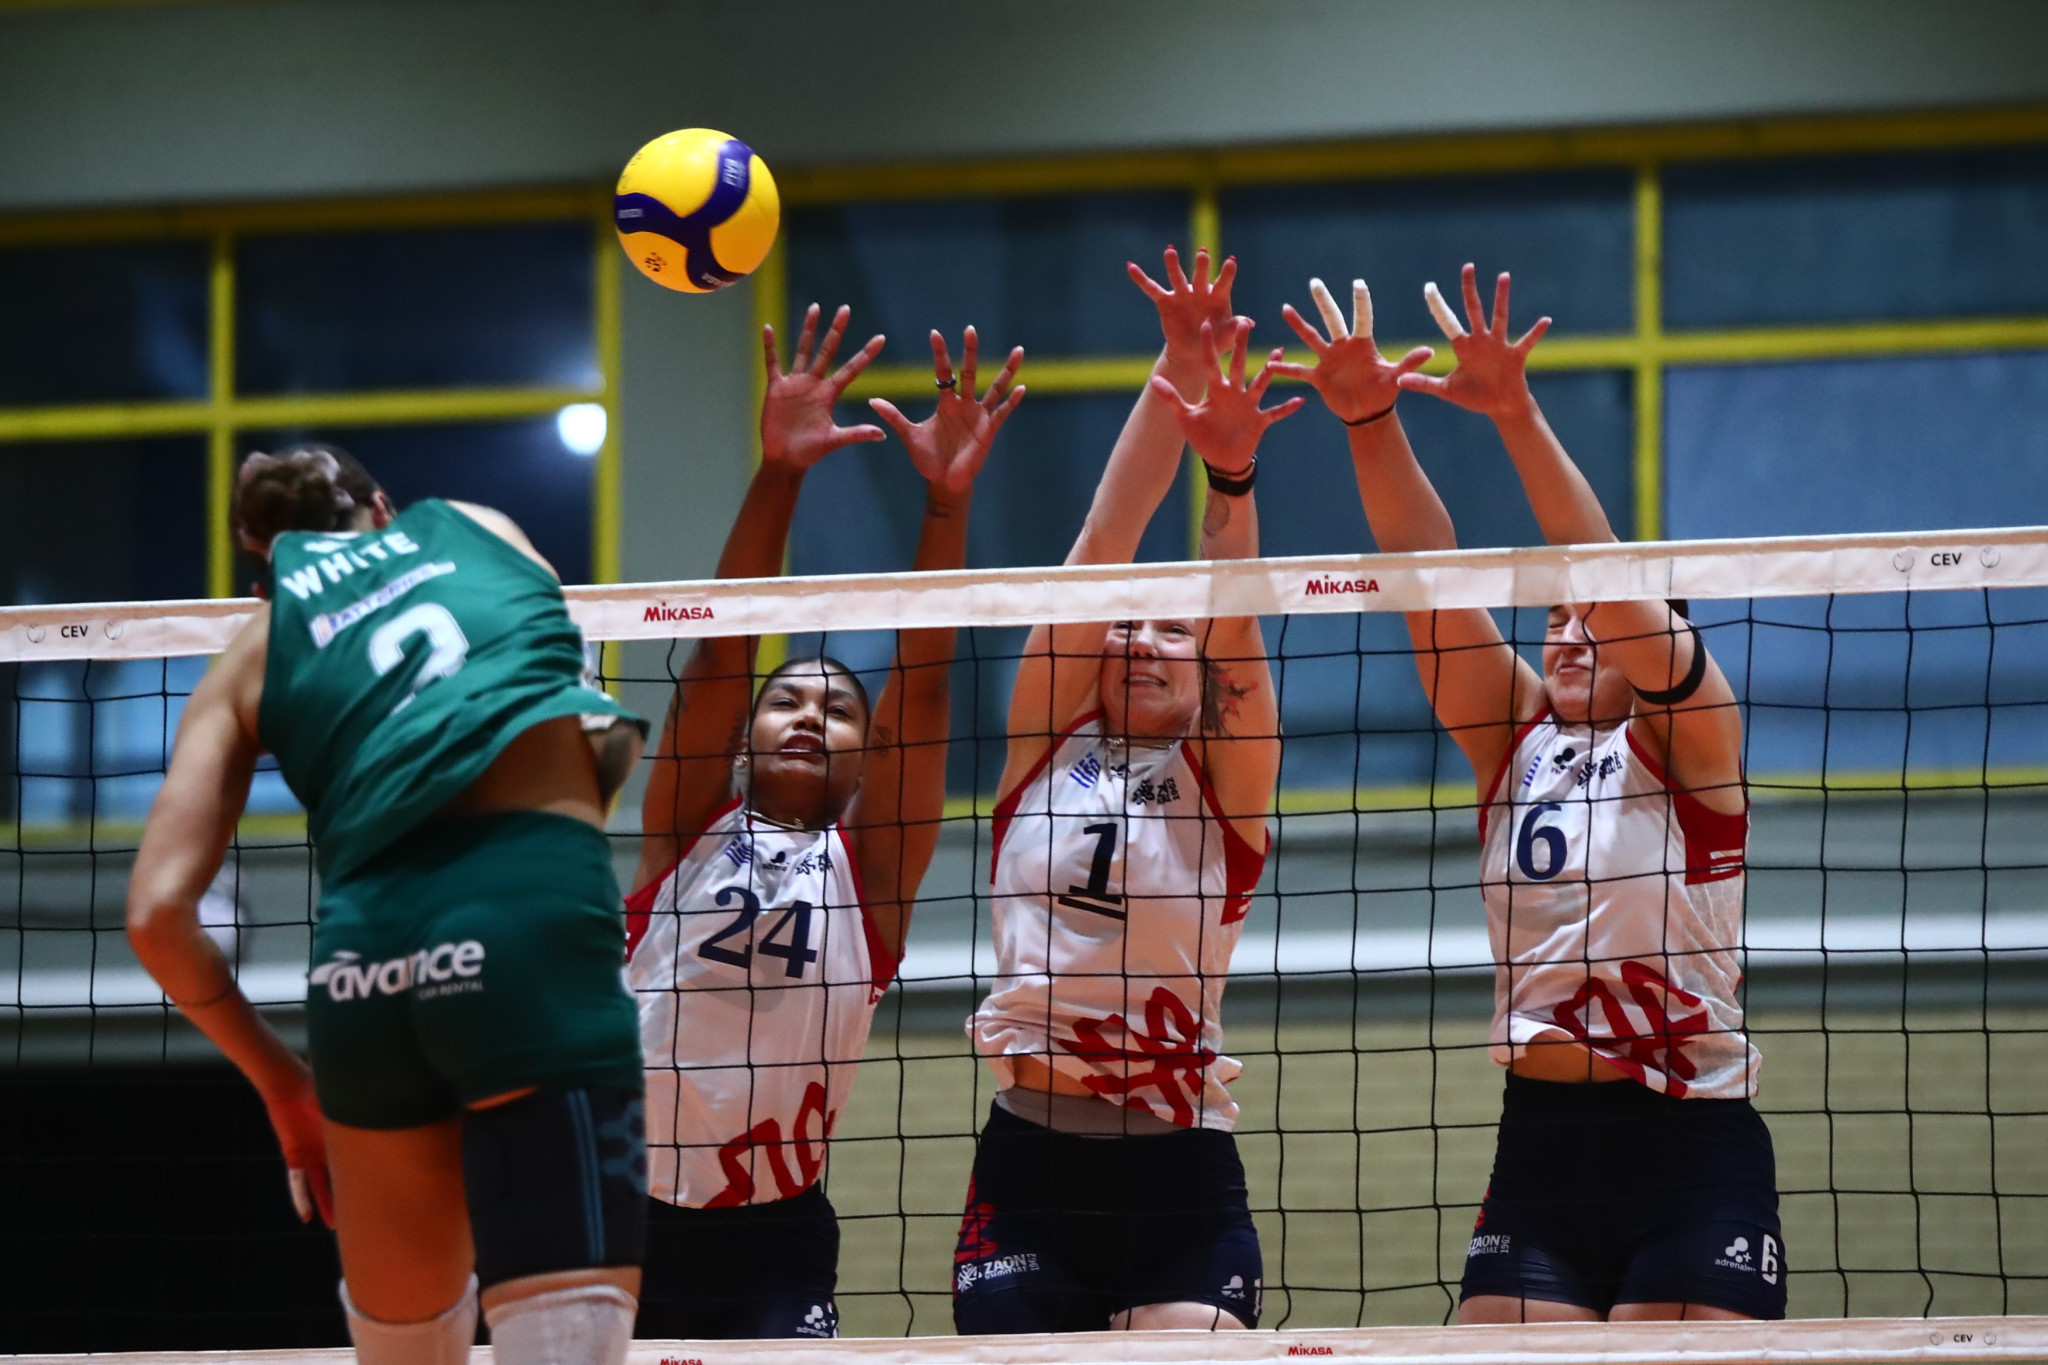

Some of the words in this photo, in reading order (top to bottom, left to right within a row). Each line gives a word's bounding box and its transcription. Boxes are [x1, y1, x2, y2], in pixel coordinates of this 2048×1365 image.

[281, 531, 420, 600] WHITE
[1931, 553, 1962, 567] CEV
[61, 625, 89, 639] CEV
[1069, 823, 1122, 905] 1
[1516, 801, 1568, 880] 6
[697, 886, 818, 979] 24
[328, 939, 486, 1001] avance
[1762, 1234, 1778, 1285] 6
[1953, 1334, 1973, 1343] CEV
